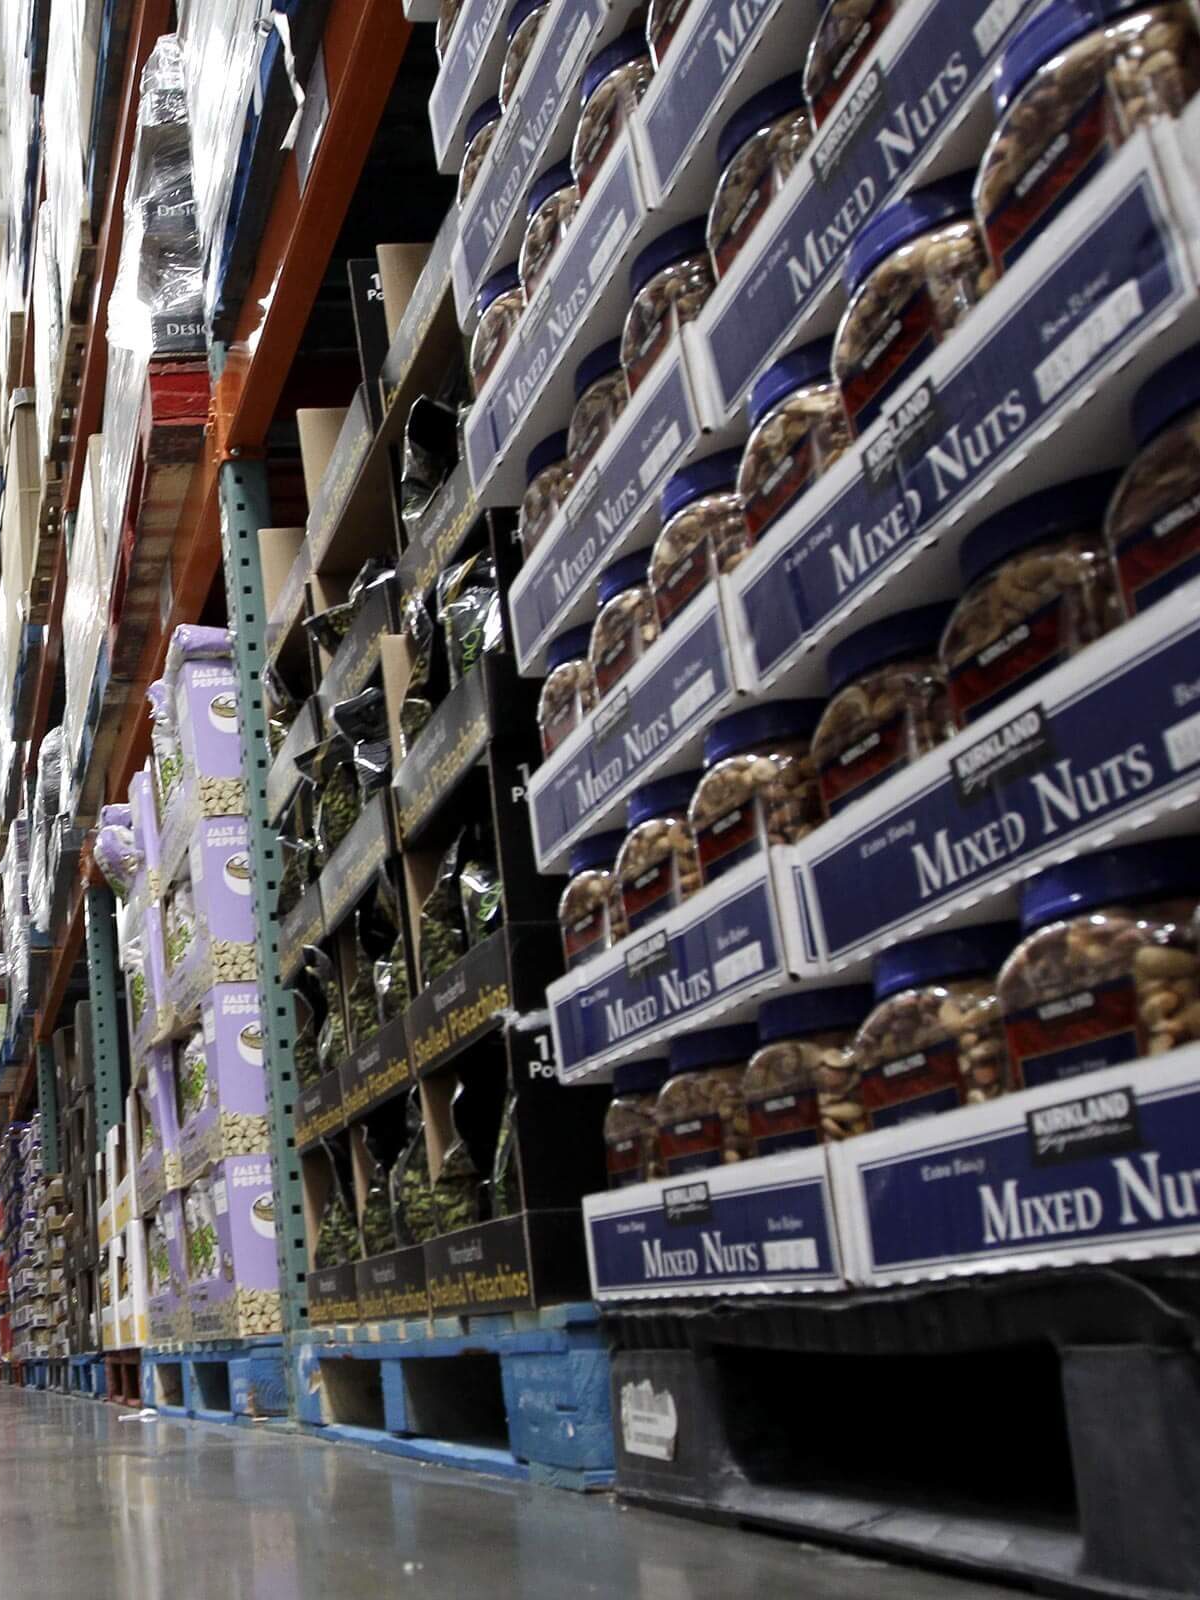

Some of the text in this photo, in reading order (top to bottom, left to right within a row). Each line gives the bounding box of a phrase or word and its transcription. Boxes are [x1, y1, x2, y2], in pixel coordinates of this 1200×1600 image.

[481, 157, 522, 249] MIXED
[518, 88, 557, 166] NUTS
[784, 52, 970, 304] MIXED NUTS
[166, 320, 210, 337] DESIG
[505, 343, 548, 424] MIXED
[546, 278, 589, 352] NUTS
[827, 388, 1028, 597] MIXED NUTS
[550, 481, 639, 606] MIXED NUTS
[575, 756, 624, 816] MIXED
[621, 713, 669, 772] NUTS
[955, 710, 1042, 778] KIRKLAND
[911, 742, 1155, 899] MIXED NUTS
[413, 983, 510, 1070] Shelled Pistachios
[604, 995, 659, 1044] MIXED
[658, 968, 714, 1017] NUTS
[528, 1062, 558, 1079] Po
[1032, 1092, 1131, 1136] KIRKLAND
[978, 1179, 1104, 1244] MIXED
[429, 1263, 530, 1310] Shelled Pistachios
[642, 1230, 761, 1279] MIXED NUTS
